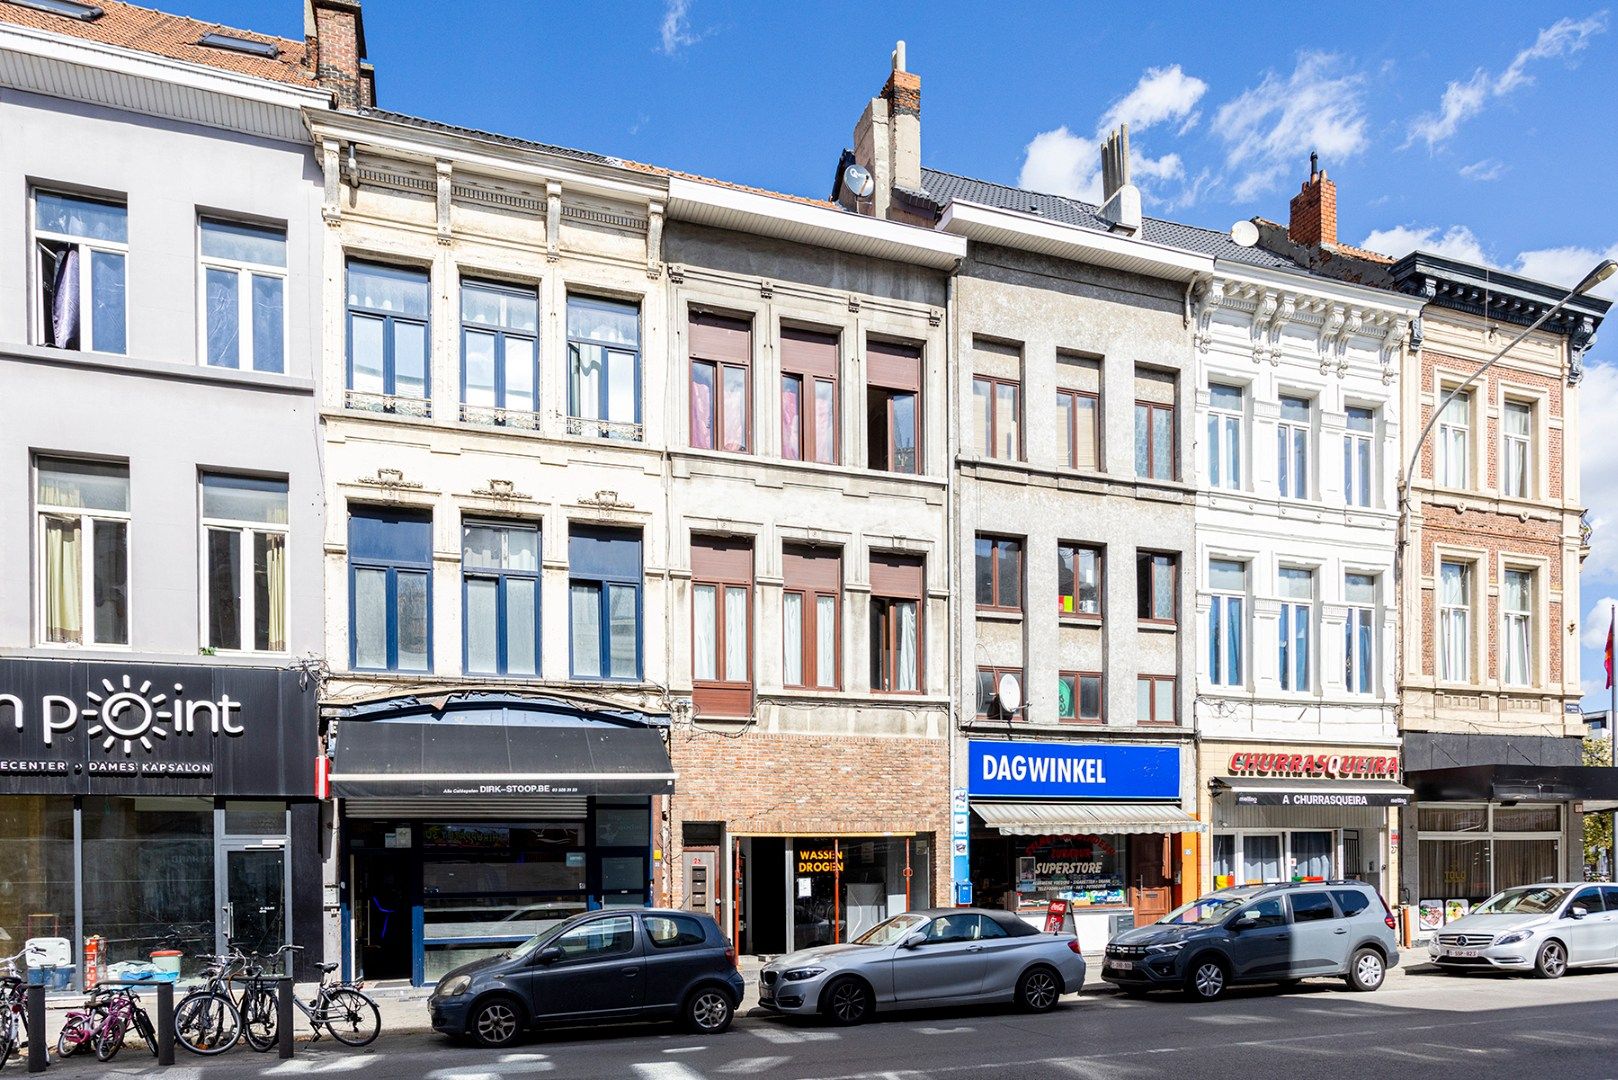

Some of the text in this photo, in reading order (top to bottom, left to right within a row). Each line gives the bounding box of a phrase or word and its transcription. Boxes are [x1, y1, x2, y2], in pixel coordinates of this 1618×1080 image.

[42, 676, 244, 753] point
[89, 762, 136, 771] DAMES
[142, 763, 211, 772] KAPSALON
[982, 754, 1107, 784] DAGWINKEL
[1230, 752, 1398, 776] CHURRASQUEIRA
[1282, 795, 1368, 806] A CHURRASQUEIRA
[798, 861, 844, 872] DROGEN
[1035, 861, 1103, 875] SUPERSTORE
